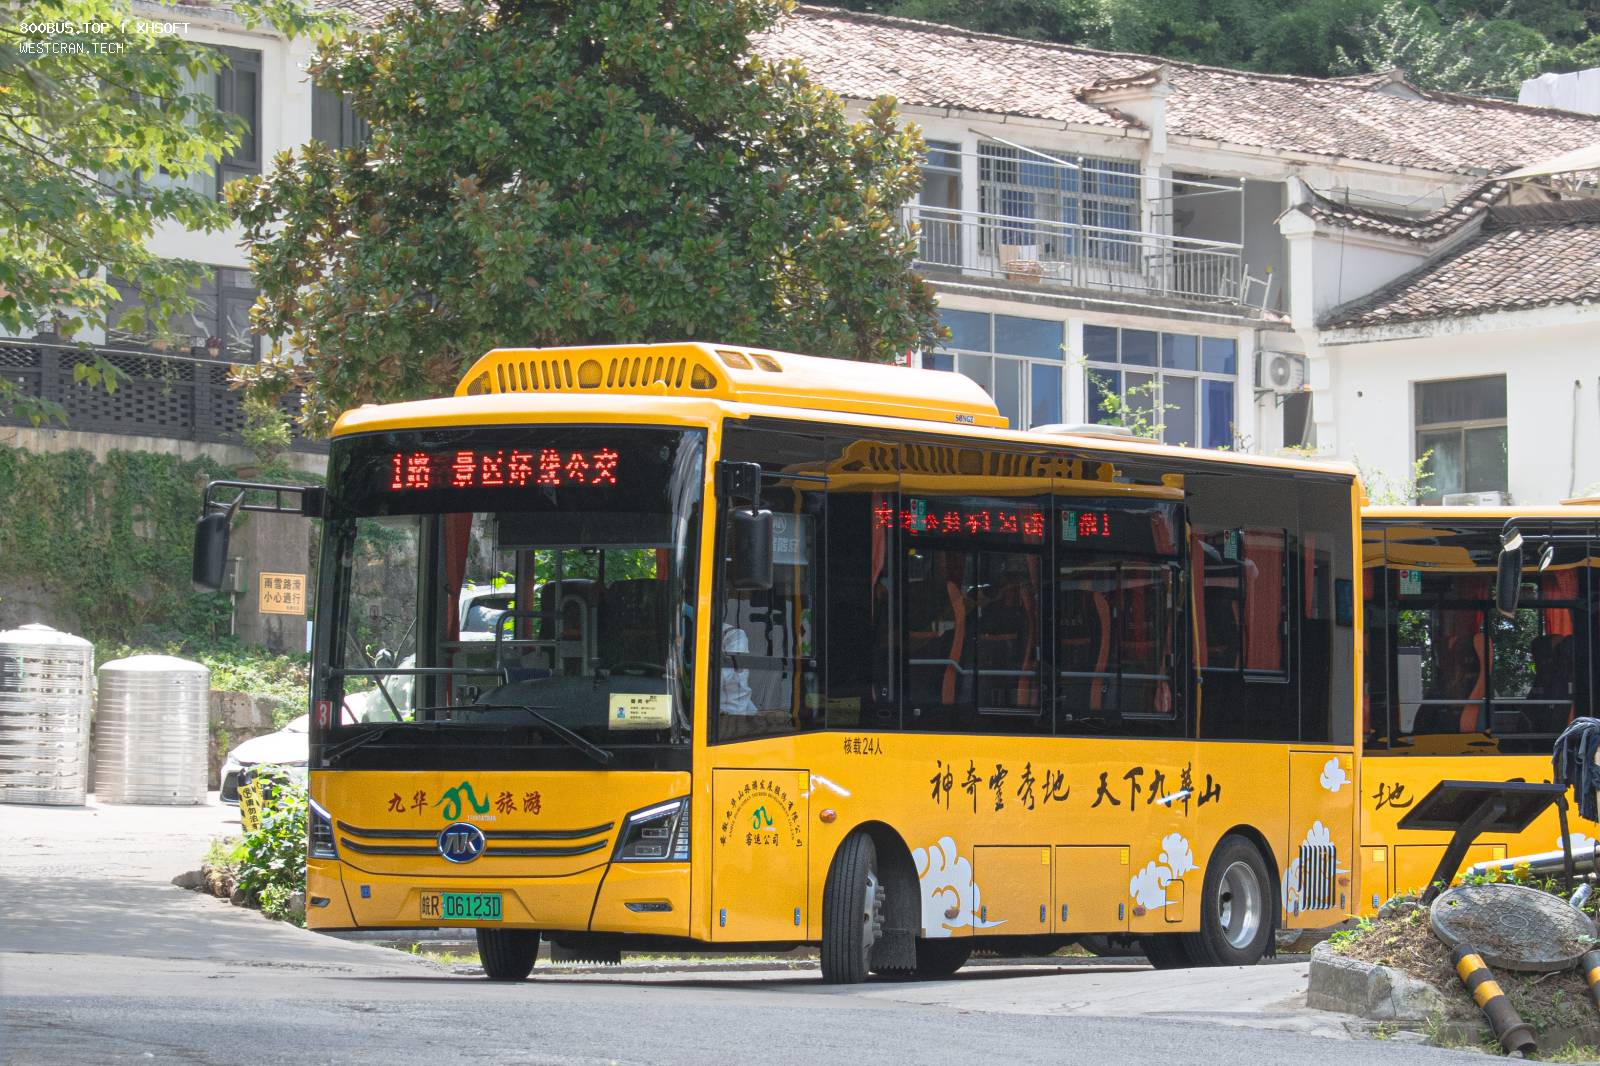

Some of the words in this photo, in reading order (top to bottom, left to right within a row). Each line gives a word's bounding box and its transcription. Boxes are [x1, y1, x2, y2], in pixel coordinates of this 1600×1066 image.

[843, 737, 883, 755] 核载24人
[388, 789, 429, 816] 九华
[495, 790, 542, 816] 旅游
[1372, 781, 1414, 811] 地
[745, 832, 779, 847] 客运公司
